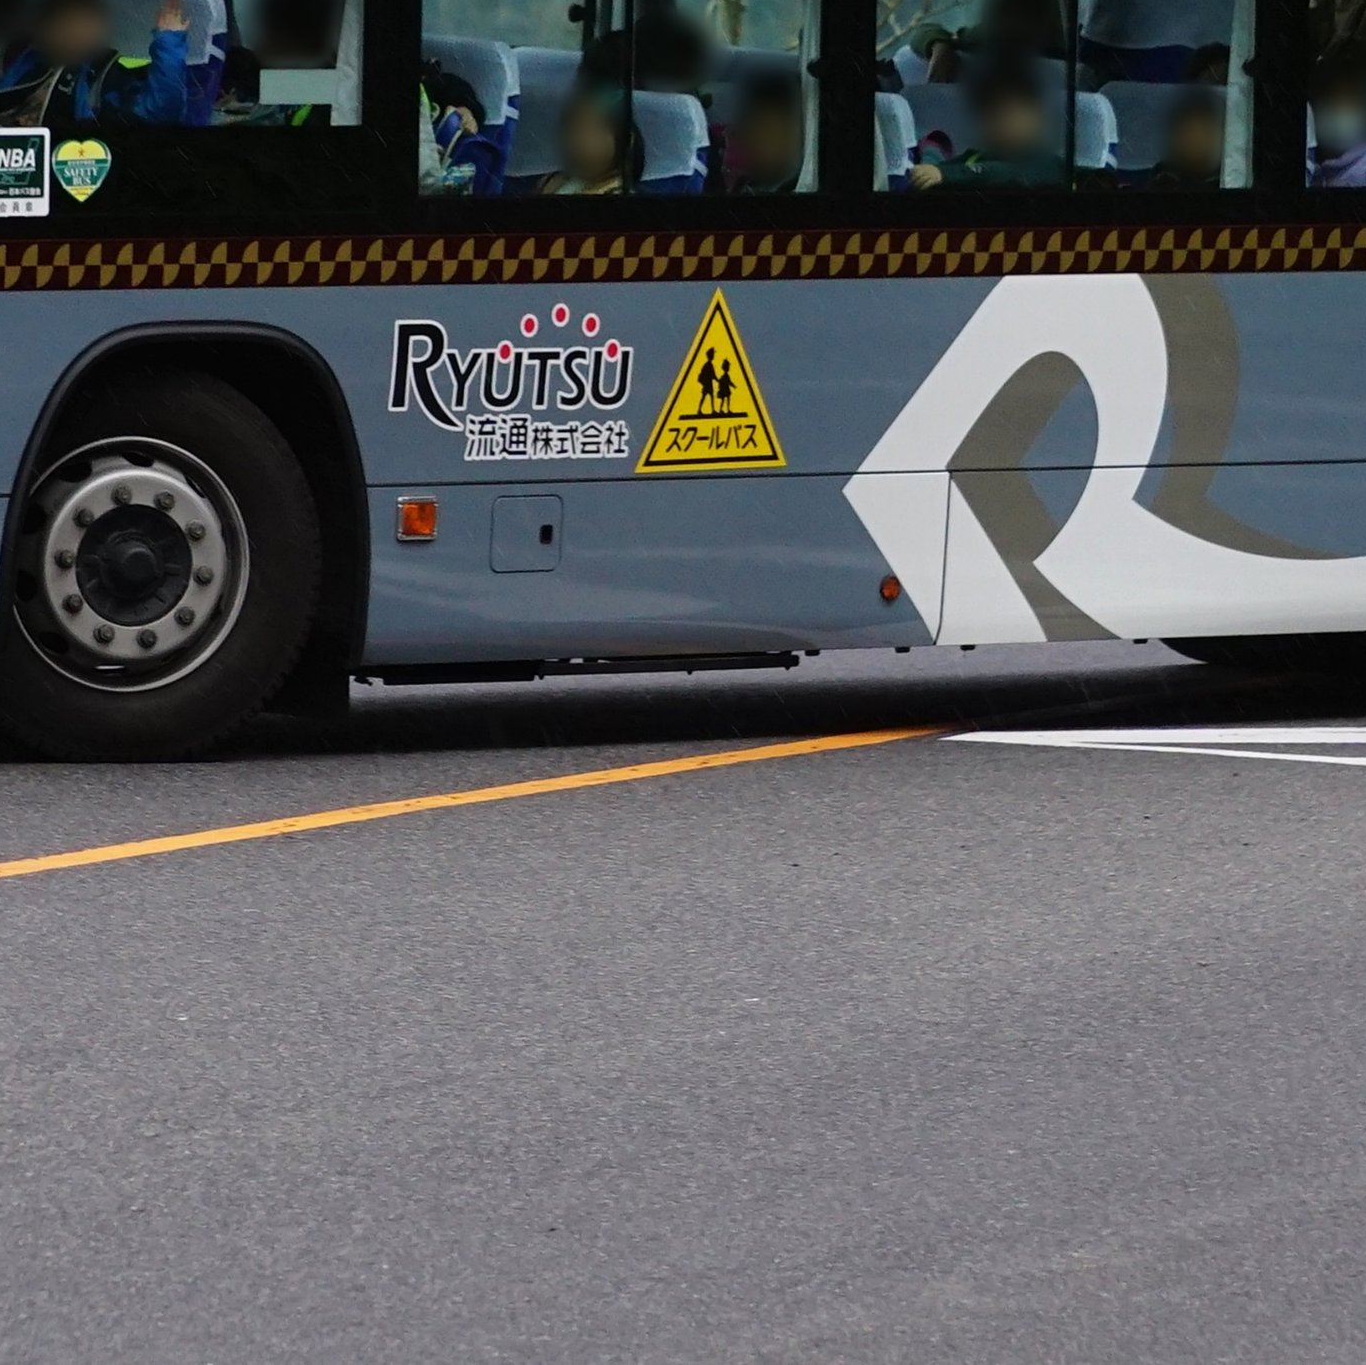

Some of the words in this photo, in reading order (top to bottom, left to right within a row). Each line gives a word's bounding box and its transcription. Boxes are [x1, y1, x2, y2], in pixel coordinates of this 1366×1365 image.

[64, 166, 98, 178] SAFETY
[388, 319, 634, 431] RYUTSU
[465, 414, 630, 460] 流通株式会社
[666, 423, 759, 453] スクールバス
